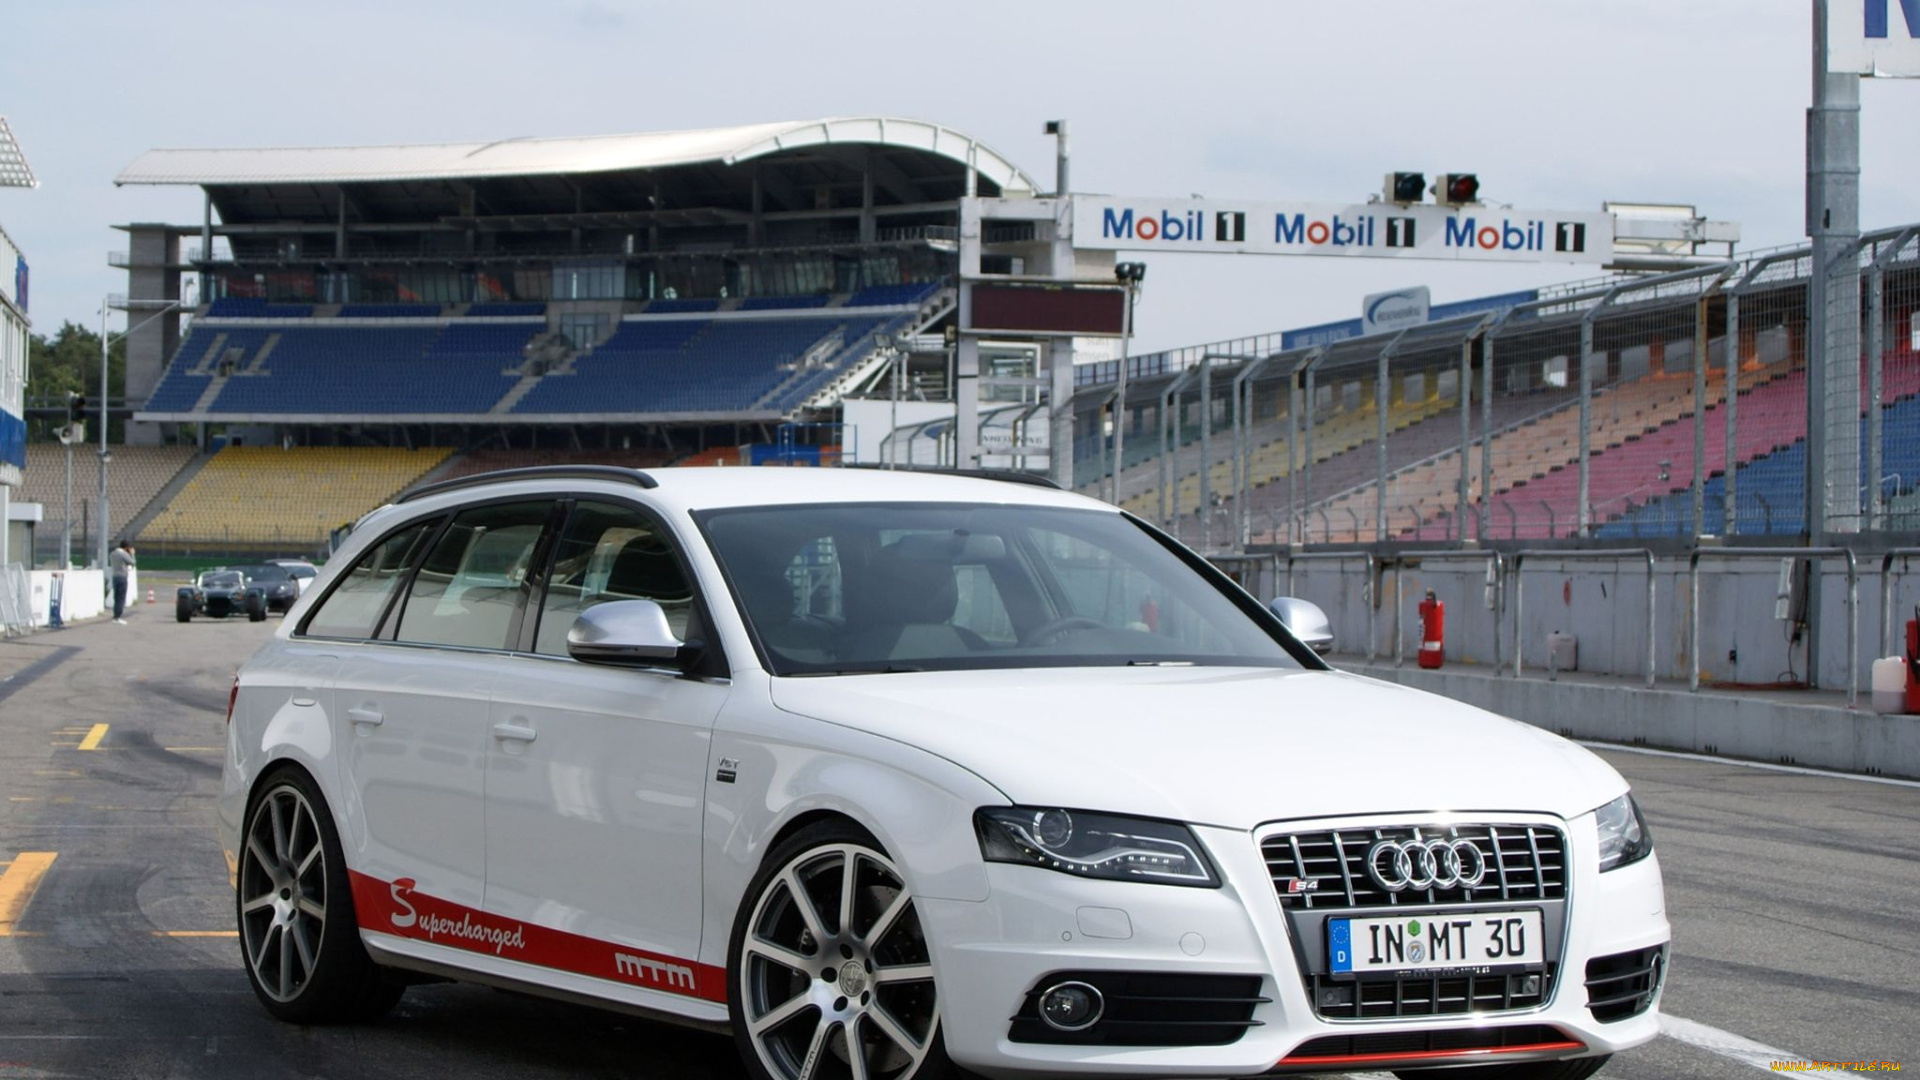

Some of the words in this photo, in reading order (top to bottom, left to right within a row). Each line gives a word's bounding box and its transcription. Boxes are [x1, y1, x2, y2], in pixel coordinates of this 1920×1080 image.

[1103, 208, 1203, 240] Mobil
[1220, 212, 1239, 241] 1
[1275, 213, 1374, 246] Mobil
[1391, 217, 1410, 248] 1
[1445, 216, 1543, 250] Mobil
[1561, 222, 1580, 253] 1
[390, 878, 525, 953] Supercharged
[1337, 951, 1346, 962] D
[1368, 924, 1405, 963] IN
[1430, 920, 1472, 960] MT
[1486, 918, 1525, 958] 30
